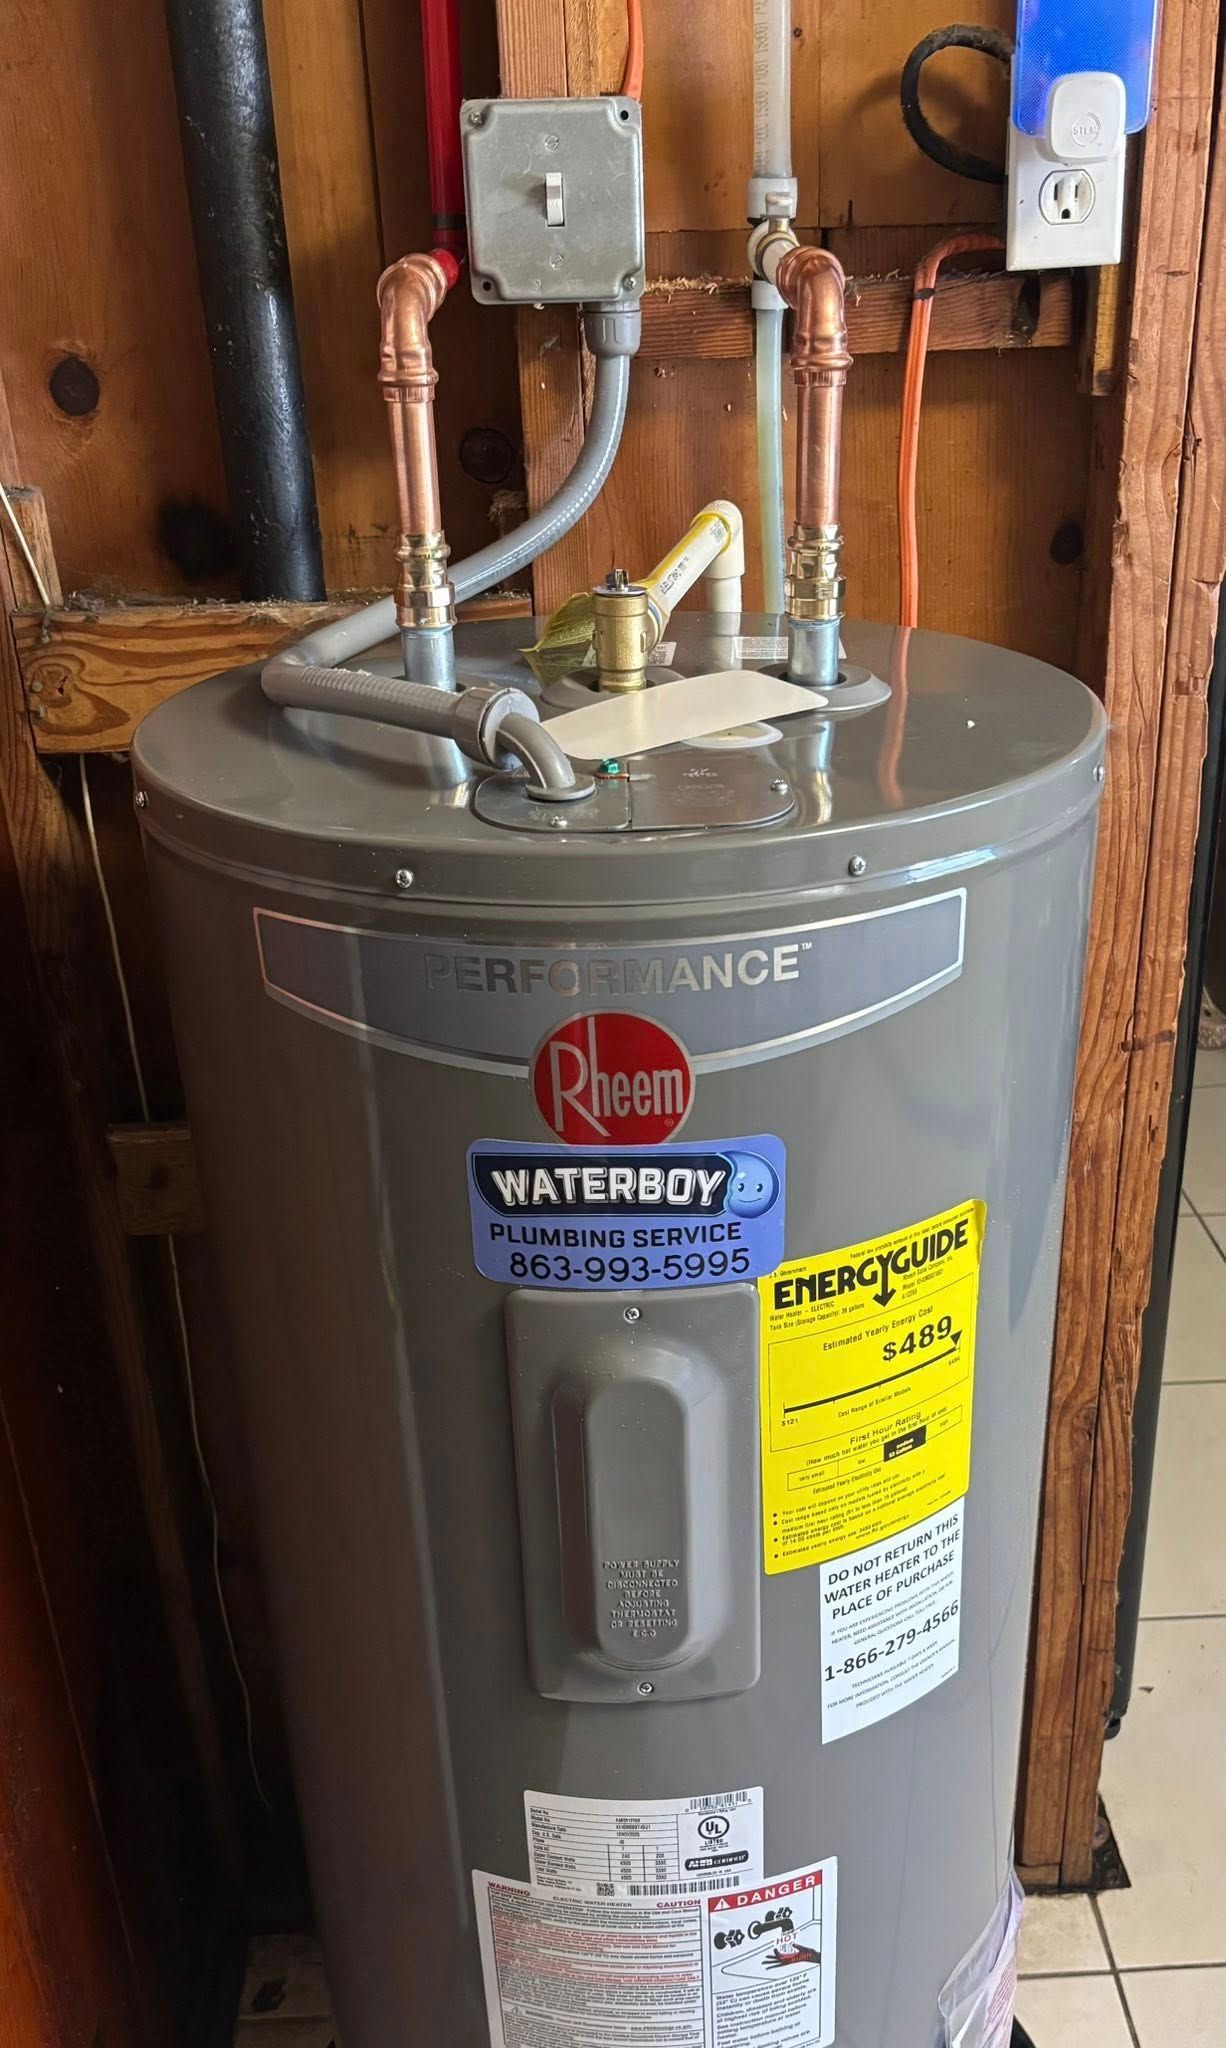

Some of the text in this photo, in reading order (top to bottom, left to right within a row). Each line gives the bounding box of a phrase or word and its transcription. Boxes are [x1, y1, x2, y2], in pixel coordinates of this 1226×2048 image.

[424, 944, 800, 997] PERFORMANCE
[549, 1016, 684, 1137] Rheem
[490, 1167, 726, 1207] WATERBOY
[490, 1222, 742, 1248] PLUMBING SERVICE
[510, 1248, 750, 1282] 863-993-5995
[774, 1218, 969, 1310] ENERGYGUIDE
[769, 1301, 834, 1321] Water Heater ELECTRIC
[823, 1305, 934, 1351] Estimated Yearly Energy Cost
[882, 1315, 952, 1362] $489
[838, 1409, 850, 1418] Cost
[851, 1404, 867, 1414] Range
[894, 1387, 912, 1397] Models
[781, 1418, 799, 1426] $121
[850, 1411, 921, 1445] First Hour Rating
[806, 1457, 821, 1466] (How
[823, 1451, 840, 1460] much
[841, 1447, 852, 1456] hot
[853, 1441, 869, 1452] water
[795, 1513, 810, 1522] range
[812, 1508, 827, 1517] based
[782, 1530, 809, 1541] Estimated
[603, 1559, 680, 1569] POWER SUPPLY
[828, 1514, 958, 1586] DO NOT RETURN THIS
[619, 1569, 664, 1579] MUST BE
[824, 1528, 960, 1604] WATER HEATER TO THE
[607, 1579, 678, 1589] DISCONNECTED
[624, 1589, 661, 1598] BEFORE
[832, 1550, 954, 1620] PLACE OF PURCHASE
[611, 1609, 676, 1618] THERMOSTAT
[617, 1599, 670, 1609] ADJUSTING
[610, 1619, 678, 1629] OR RESETTING
[832, 1608, 908, 1644] HEATER, NEED ASSISTANCE WITH
[837, 1626, 848, 1634] YOU
[848, 1621, 858, 1629] ARE
[859, 1606, 893, 1625] EXPERIENCING
[854, 1633, 876, 1645] GENERAL
[877, 1620, 903, 1636] QUESTIONS
[904, 1614, 914, 1622] CALL
[824, 1599, 958, 1681] 1-866-279-4566
[838, 1695, 854, 1705] MORE
[890, 1669, 910, 1681] CONSULT
[852, 1671, 884, 1689] TECHNICIANS
[884, 1660, 907, 1674] AVAILABLE
[856, 1694, 880, 1708] PROVIDED
[881, 1688, 894, 1696] WITH
[903, 1673, 918, 1684] WATER
[705, 1821, 722, 1834] UL
[488, 1881, 530, 1896] WARNING
[553, 1896, 582, 1905] ELECTRIC
[656, 1900, 701, 1908] CAUTION
[737, 1875, 816, 1906] DANGER
[776, 1932, 798, 1944] HOT
[735, 1984, 773, 1997] temperature
[771, 1984, 791, 1993] severe
[716, 2003, 743, 2011] instantly
